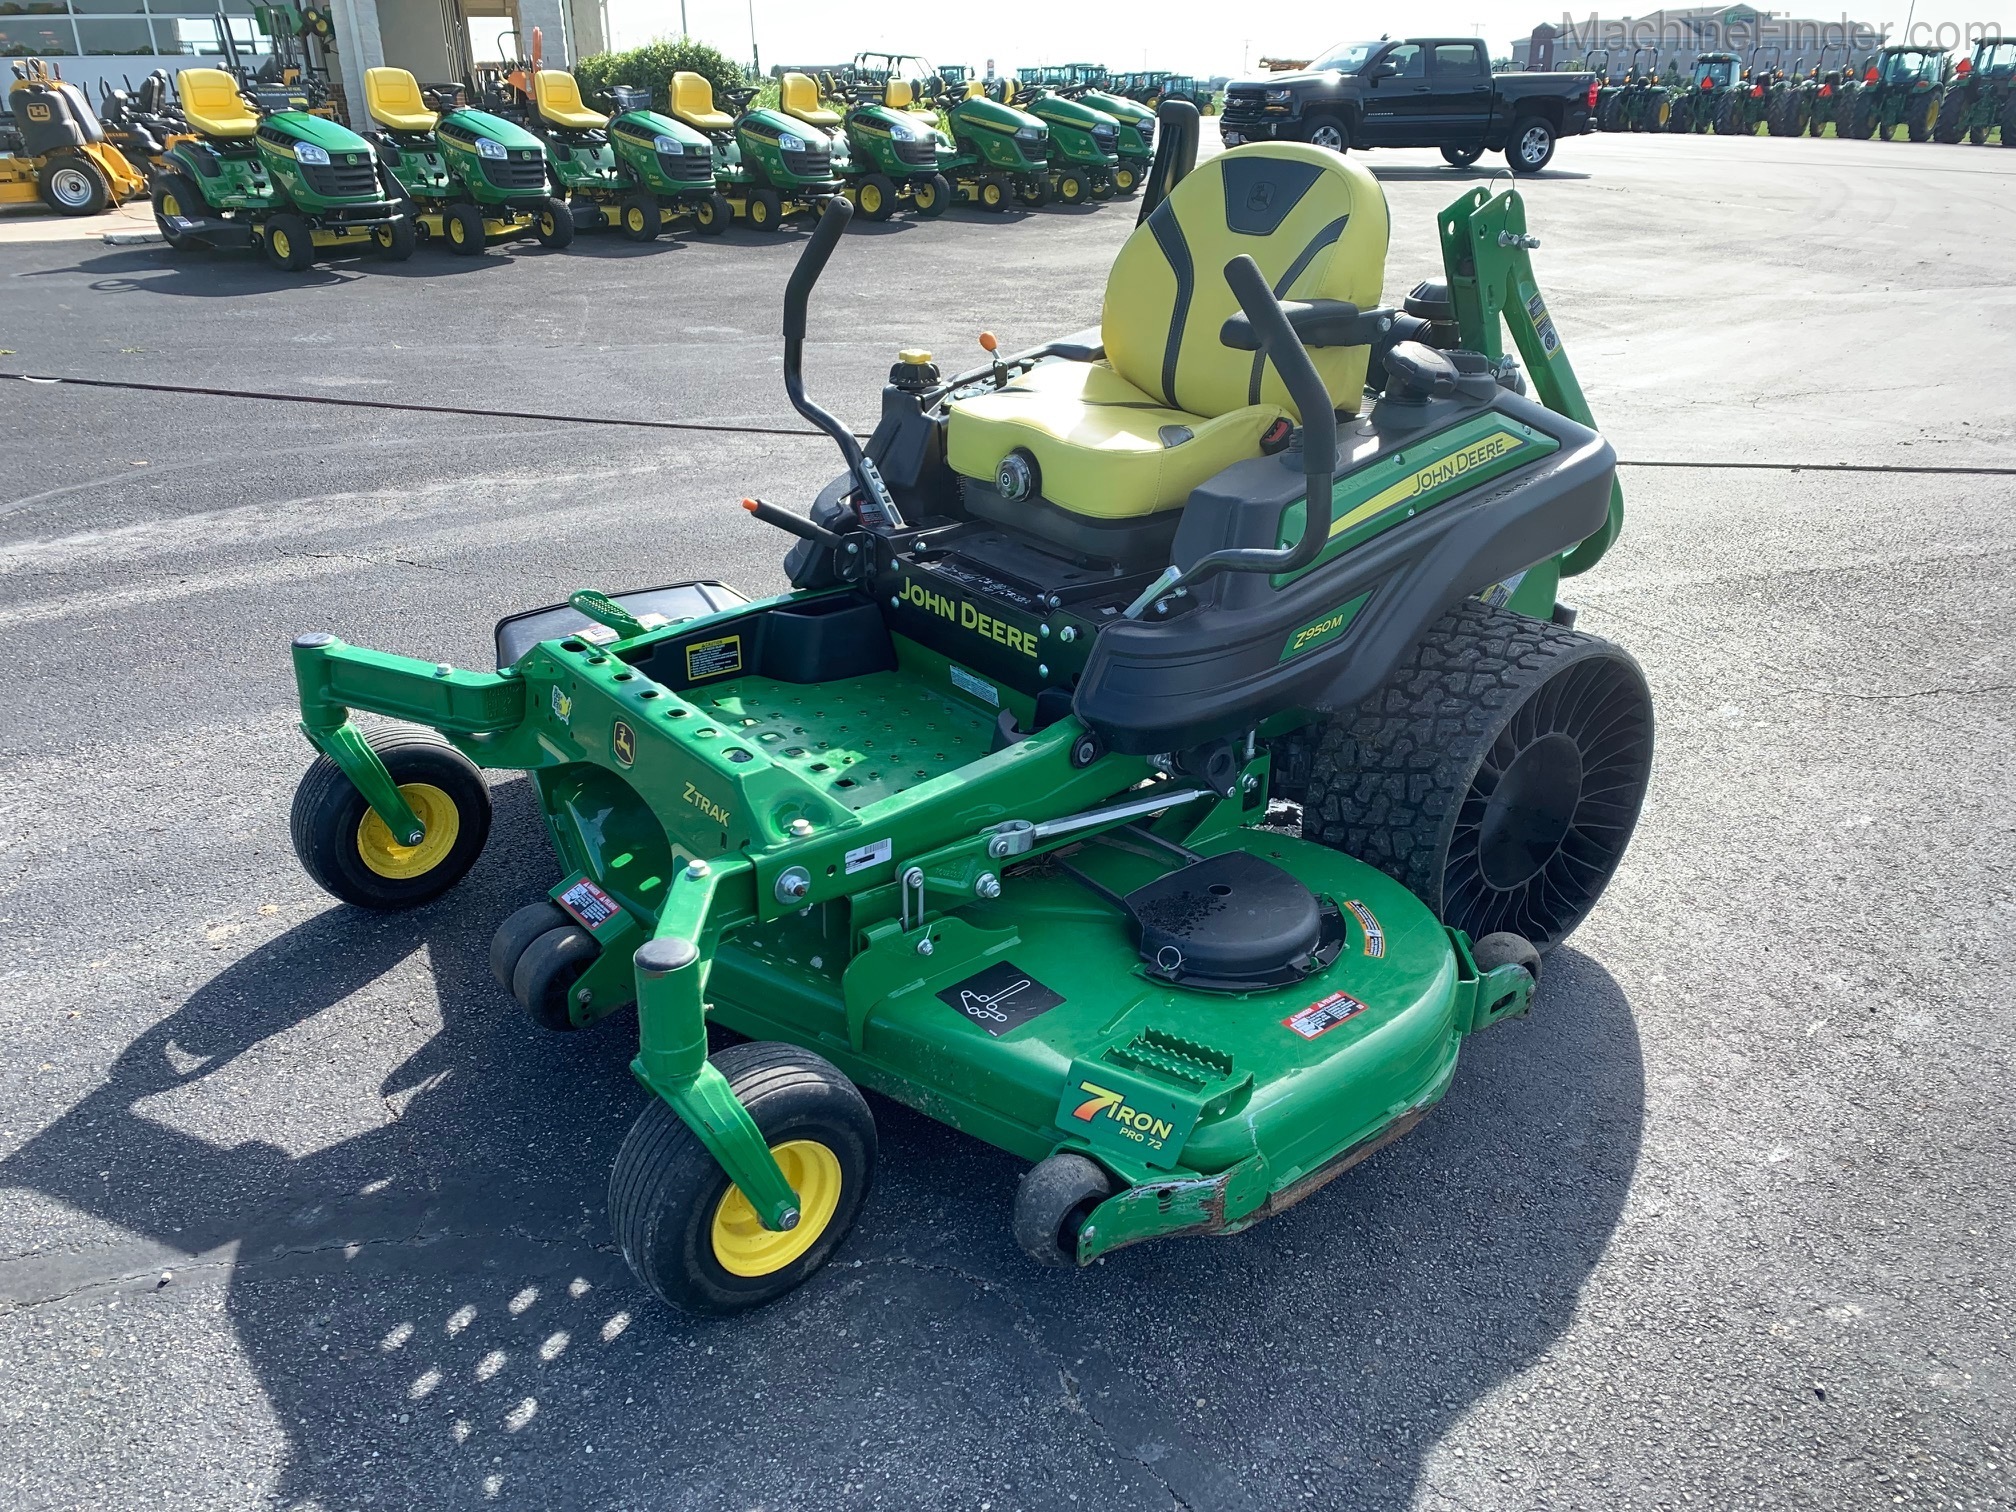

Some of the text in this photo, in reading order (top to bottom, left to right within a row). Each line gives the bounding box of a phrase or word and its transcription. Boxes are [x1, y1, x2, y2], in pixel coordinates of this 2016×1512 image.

[1413, 438, 1505, 496] JOHN DEERE
[899, 577, 955, 622] JOHN
[961, 601, 1038, 658] DEERE
[1293, 613, 1344, 650] Z950M
[682, 780, 731, 828] ZTRAK
[1119, 1126, 1163, 1151] PRO 72
